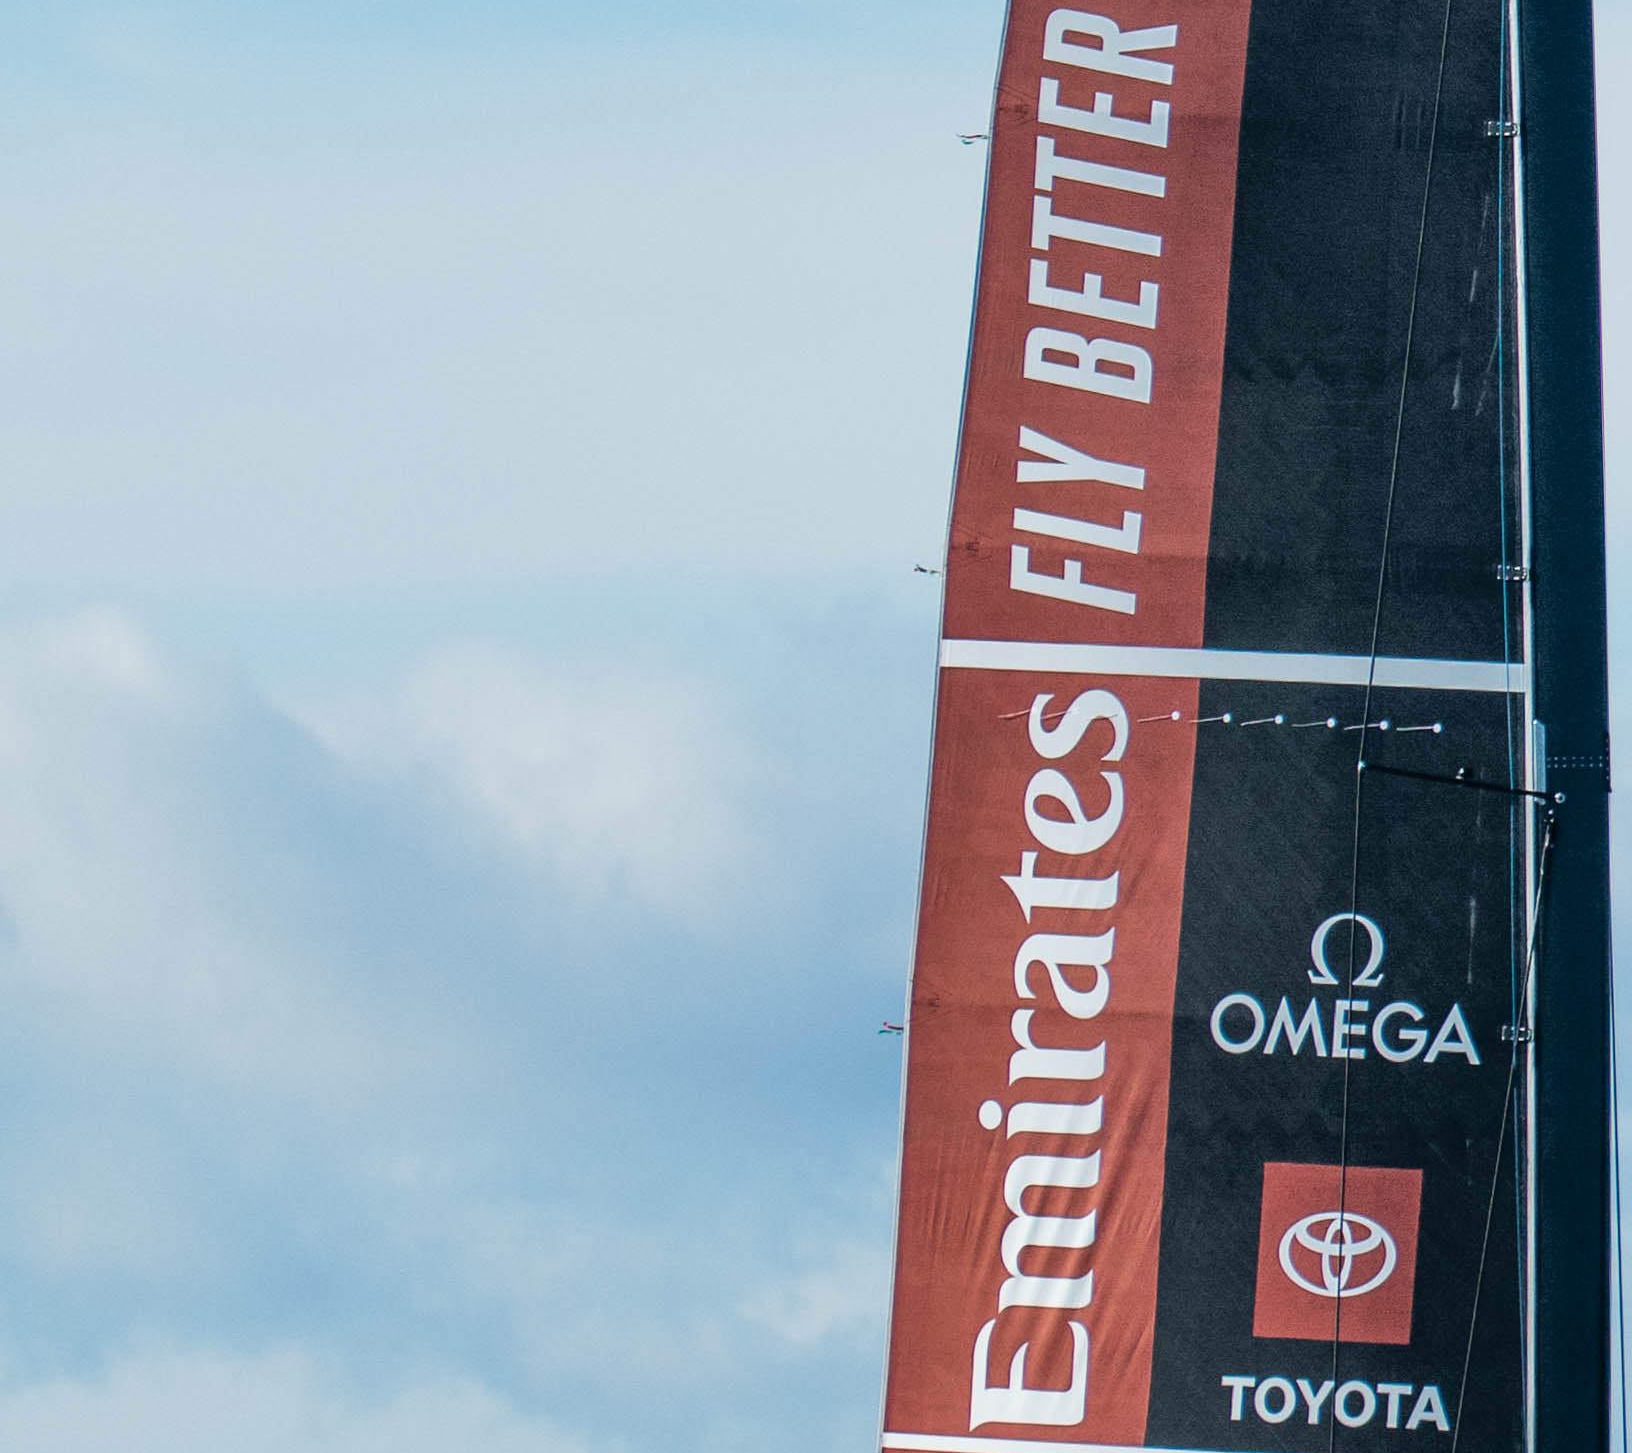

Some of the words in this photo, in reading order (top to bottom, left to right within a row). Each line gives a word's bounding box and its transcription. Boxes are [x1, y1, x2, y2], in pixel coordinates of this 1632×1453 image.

[1023, 8, 1179, 404] BETTER
[1010, 425, 1146, 615] FLY
[969, 689, 1130, 1432] Emirates
[1210, 993, 1481, 1066] OMEGA
[1220, 1375, 1451, 1432] TOYOTA
